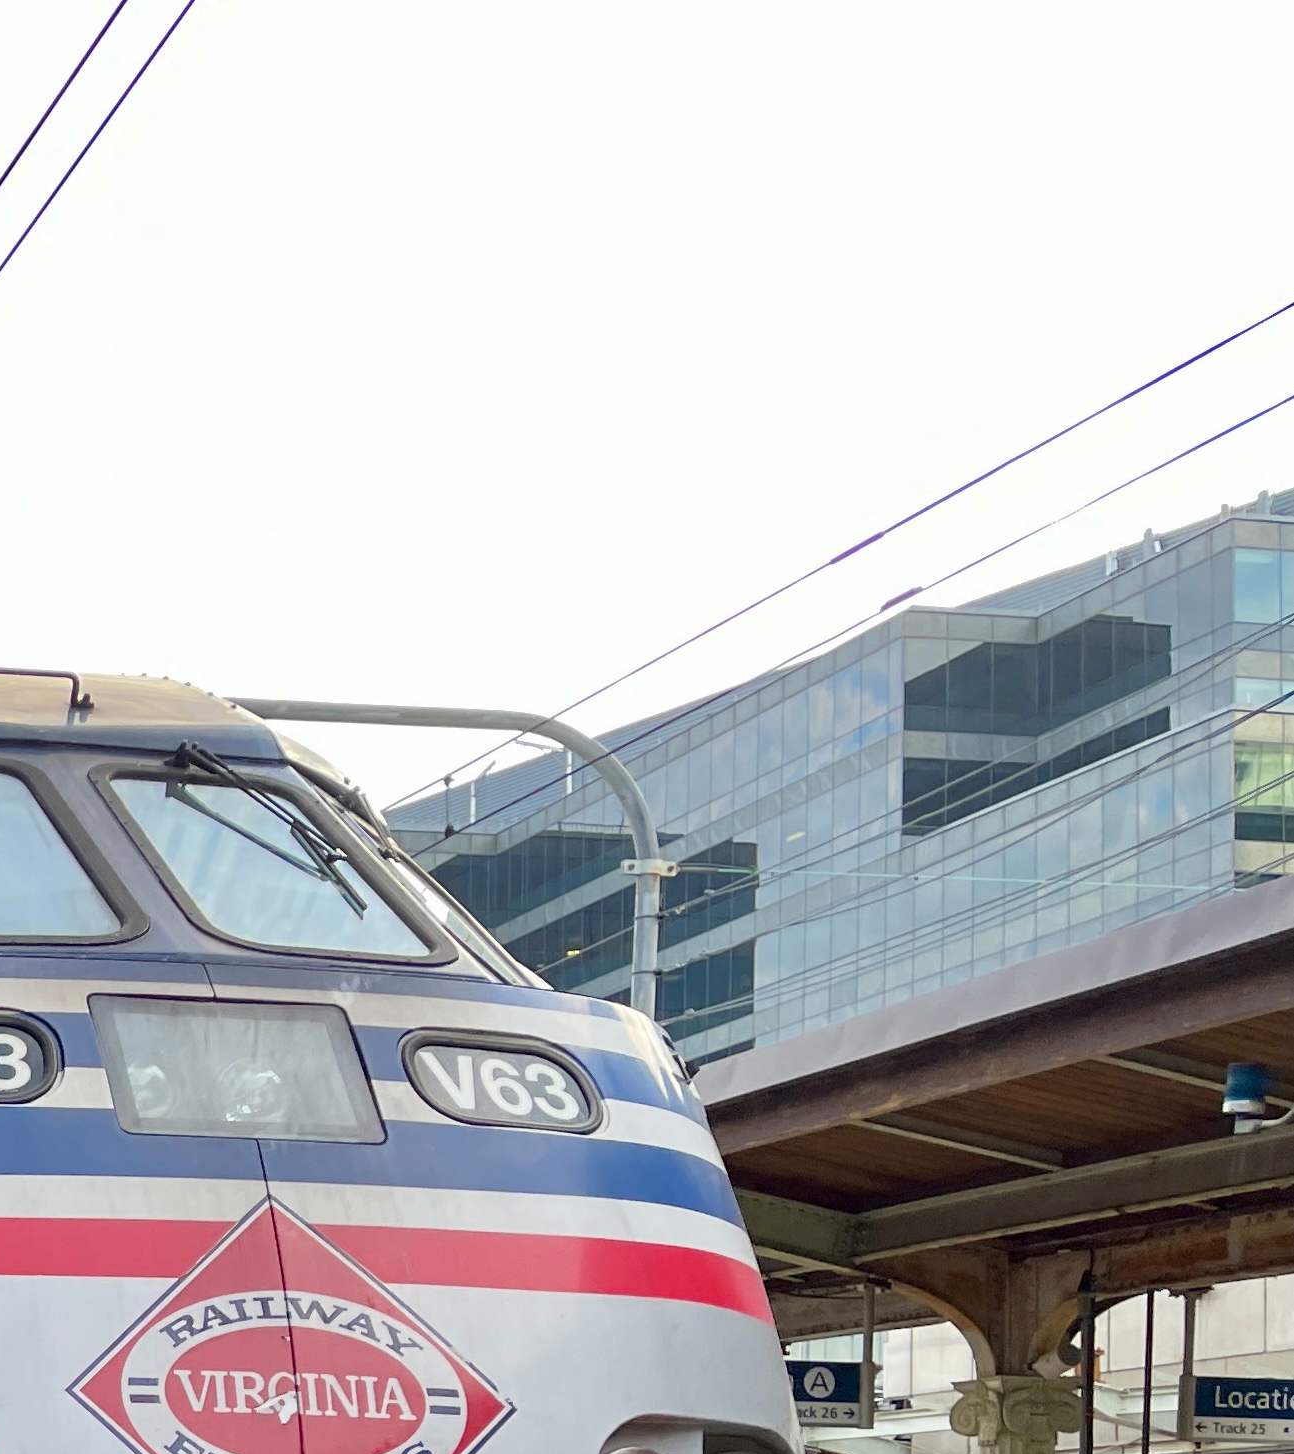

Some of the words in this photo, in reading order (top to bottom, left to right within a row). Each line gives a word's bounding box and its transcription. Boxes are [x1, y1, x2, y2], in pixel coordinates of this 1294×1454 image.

[417, 1047, 579, 1122] V63
[159, 1297, 423, 1357] RAILWAY
[173, 1369, 417, 1421] VIRGINIA
[809, 1371, 829, 1391] A
[821, 1407, 838, 1419] 26
[1214, 1422, 1247, 1434] Track
[1251, 1424, 1266, 1435] 25
